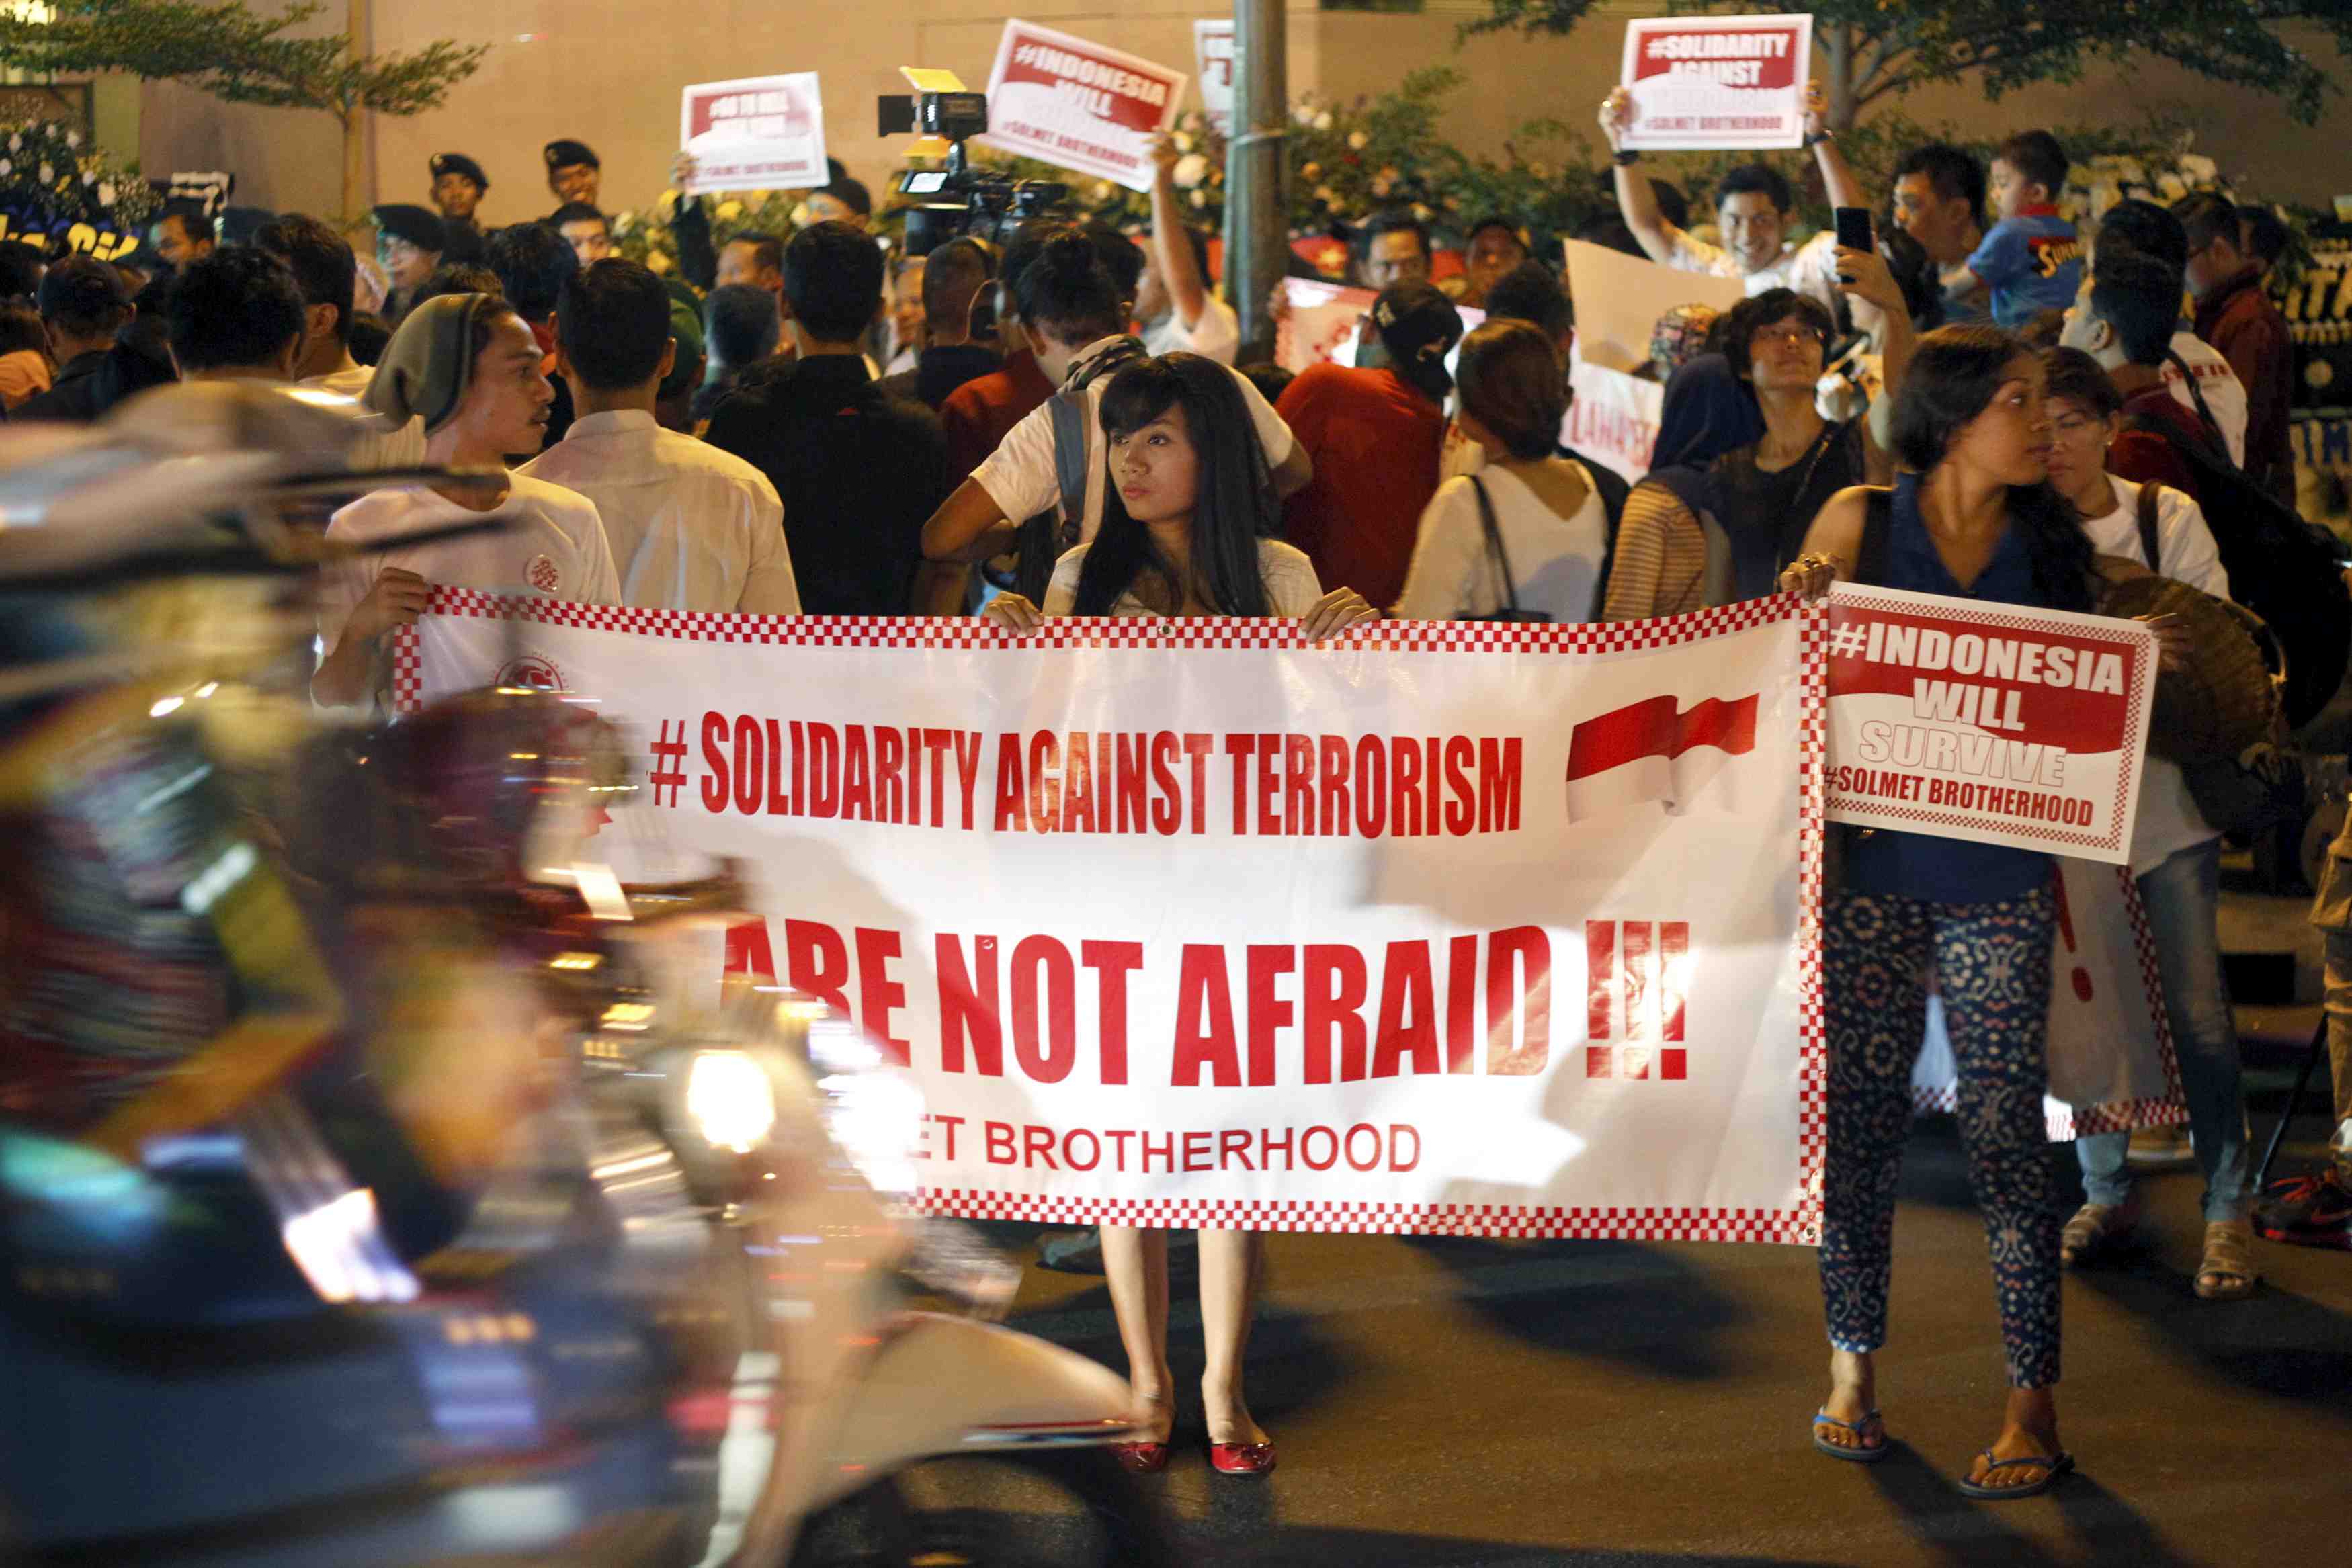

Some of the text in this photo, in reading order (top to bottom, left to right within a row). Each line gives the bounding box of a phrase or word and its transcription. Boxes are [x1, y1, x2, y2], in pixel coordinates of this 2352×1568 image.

[1015, 44, 1167, 107] #INDONESIA
[1646, 34, 1789, 58] #SOLIDARITY
[1669, 60, 1763, 85] AGAINST
[1054, 79, 1114, 118] WILL
[1828, 621, 2124, 696] #INDONESIA
[1913, 677, 2025, 732] WILL
[994, 729, 1214, 837] AGAINST
[1225, 733, 1523, 840] TERRORISM
[1859, 720, 2067, 788] SURVIVE
[1824, 766, 2094, 827] #SOLMET BROTHERHOOD
[935, 932, 1144, 1084] NOT
[1170, 924, 1552, 1088] AFRAID
[984, 1120, 1422, 1174] BROTHERHOOD
